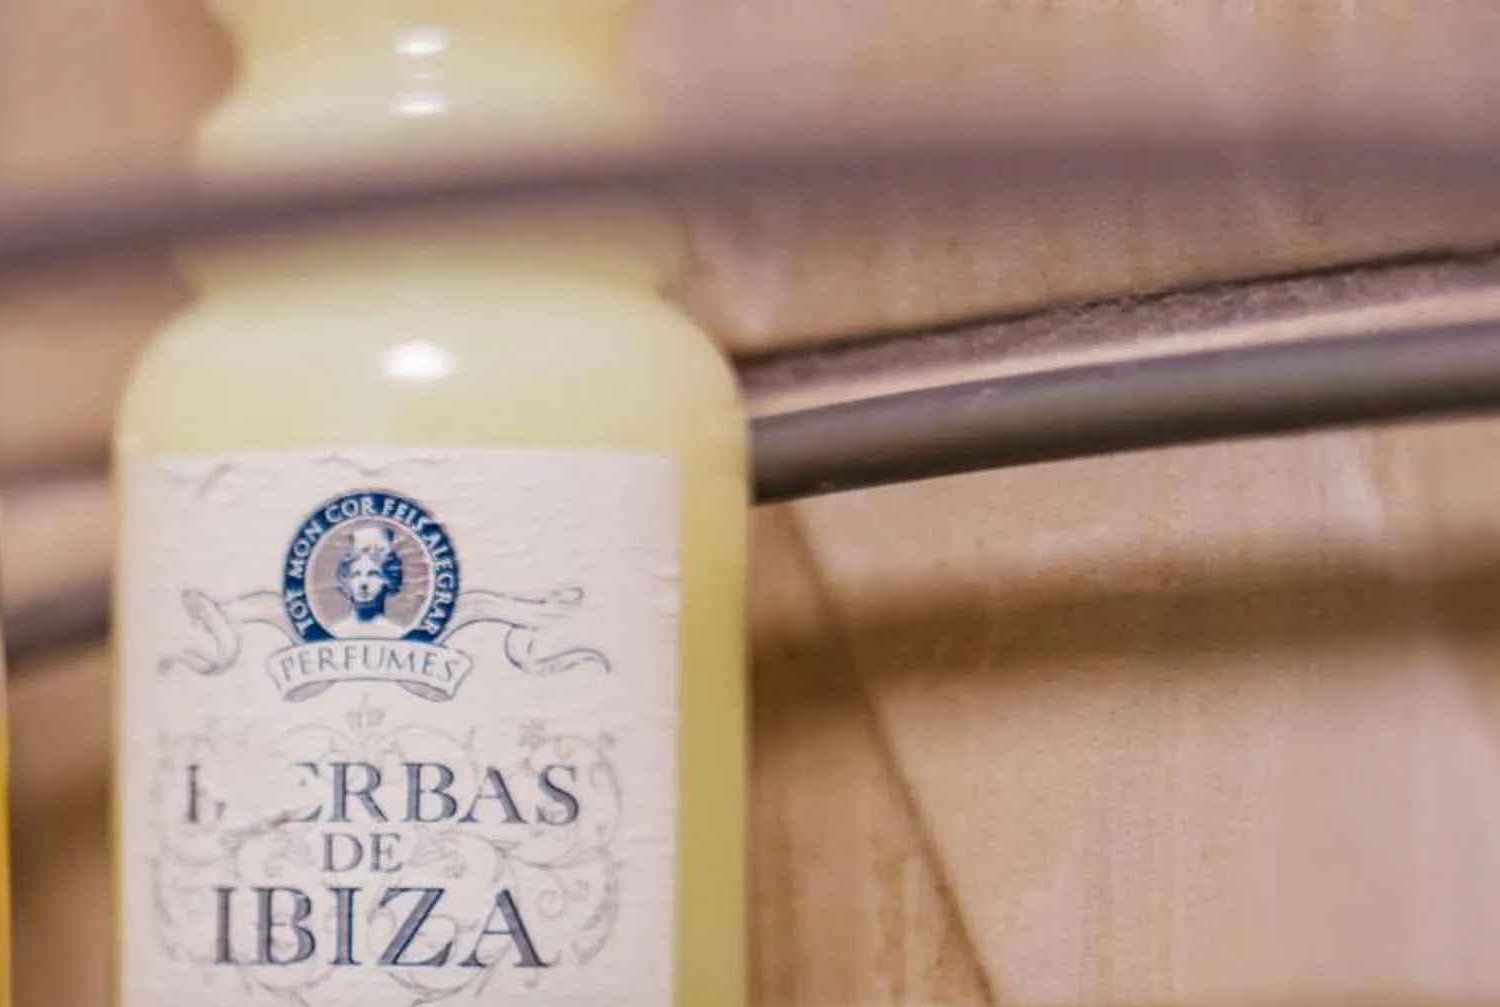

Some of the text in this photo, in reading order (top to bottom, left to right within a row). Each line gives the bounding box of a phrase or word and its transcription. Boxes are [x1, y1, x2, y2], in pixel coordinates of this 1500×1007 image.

[290, 523, 324, 579] MON
[325, 497, 374, 522] COR
[420, 532, 454, 635] ALEGRAR
[280, 645, 459, 682] PERFUMES
[322, 832, 404, 873] DE
[212, 886, 553, 969] IBIZA
